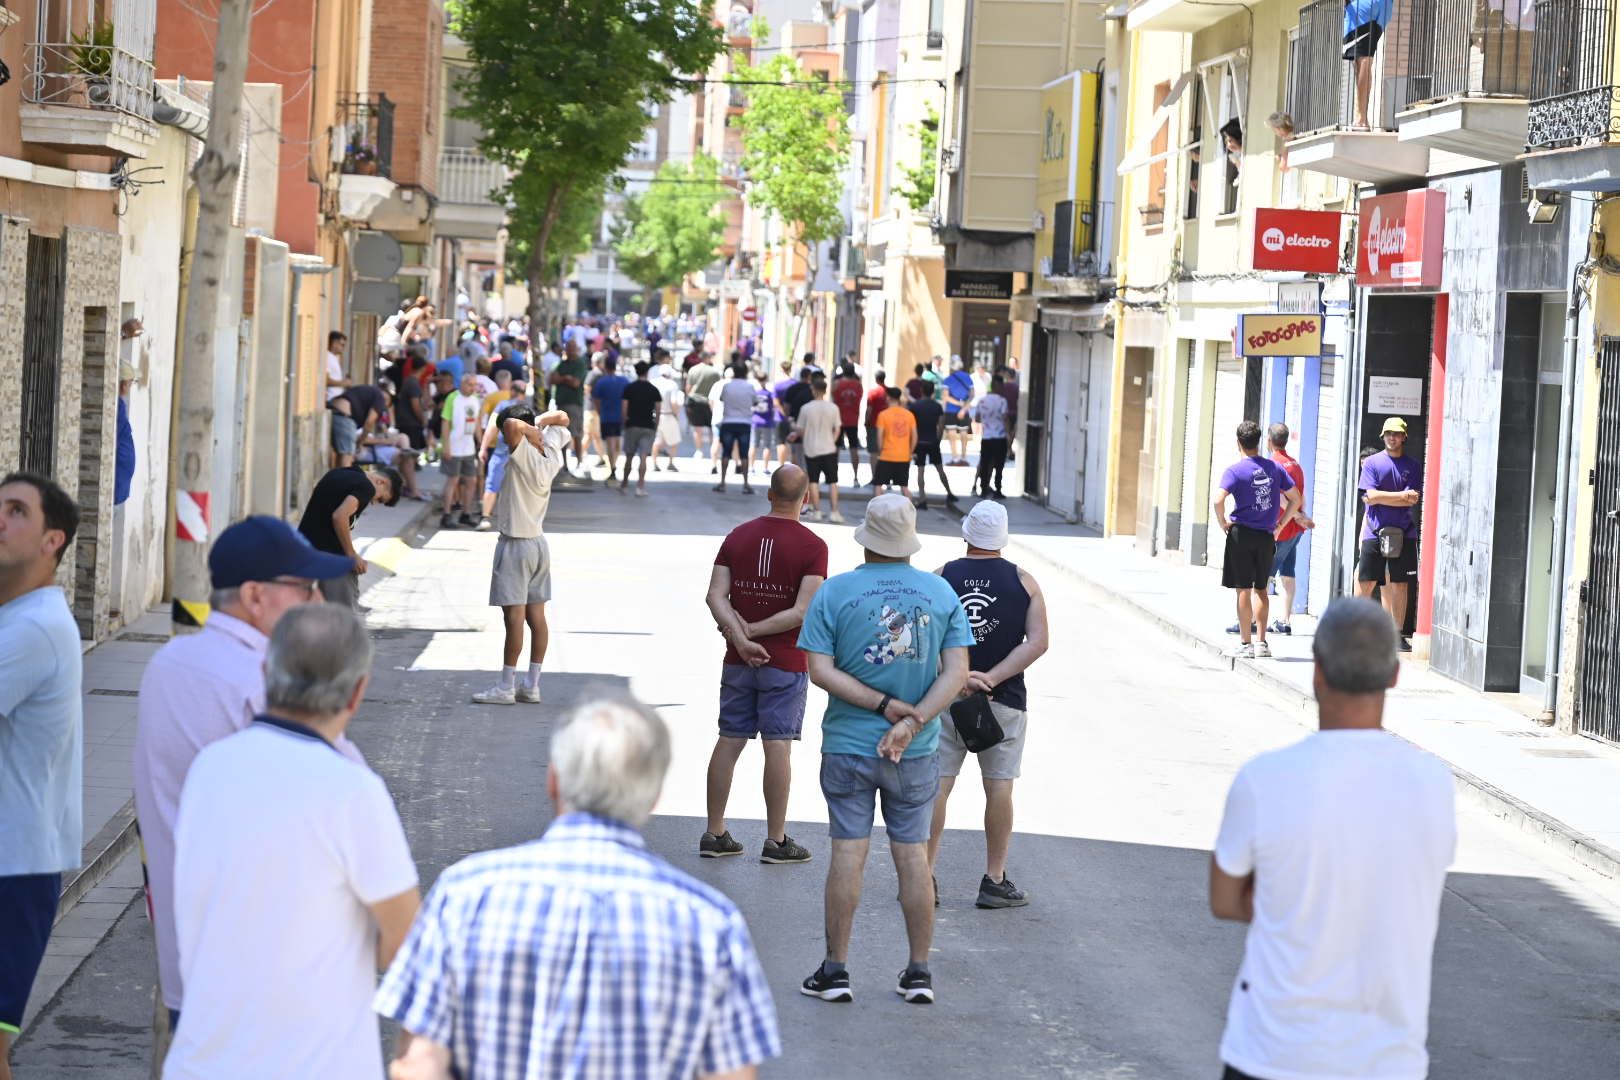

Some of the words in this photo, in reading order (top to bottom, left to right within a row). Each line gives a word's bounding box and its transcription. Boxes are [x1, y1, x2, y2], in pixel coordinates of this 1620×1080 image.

[1266, 234, 1280, 244] mi
[1286, 233, 1331, 248] electro
[1247, 320, 1317, 349] FOTOCOPIAS
[964, 579, 990, 588] COLLA
